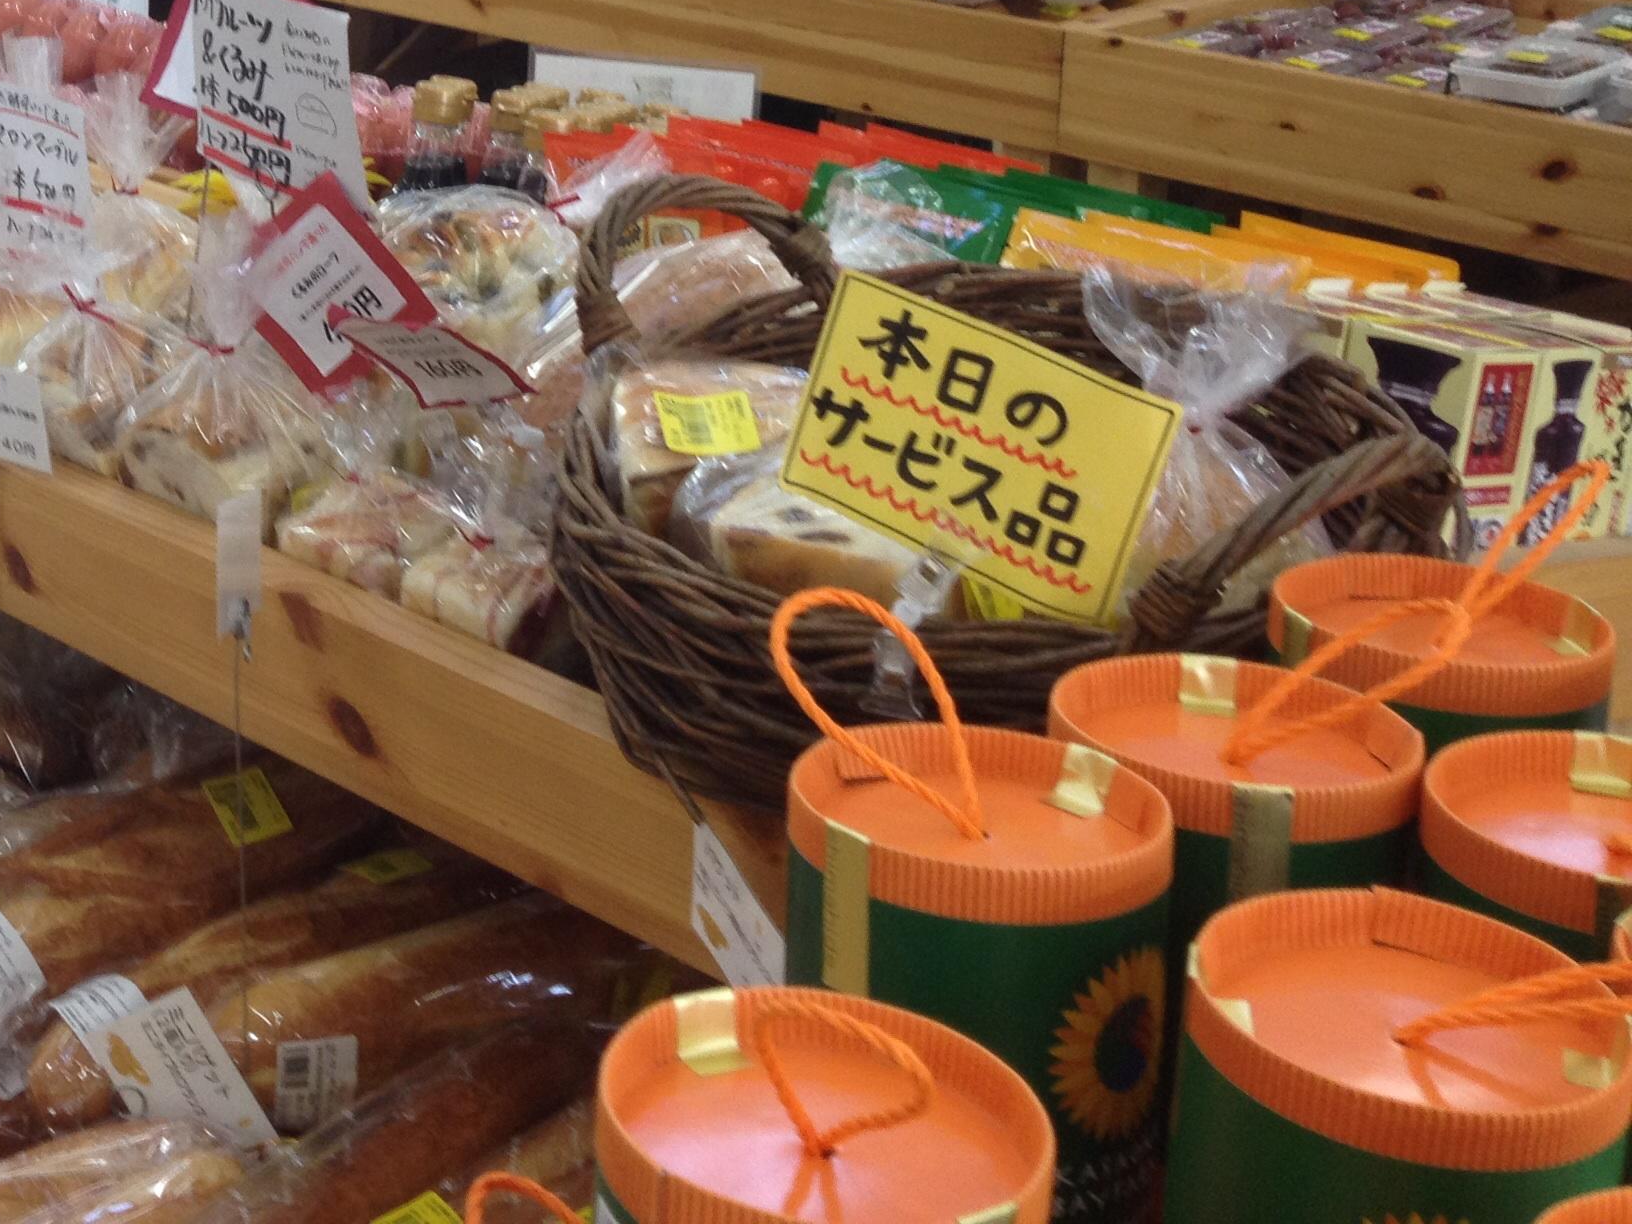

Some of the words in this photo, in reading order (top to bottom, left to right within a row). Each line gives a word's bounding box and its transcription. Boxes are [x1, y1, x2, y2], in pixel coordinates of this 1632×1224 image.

[856, 308, 1070, 448] 本日の
[811, 387, 1087, 568] サービス品
